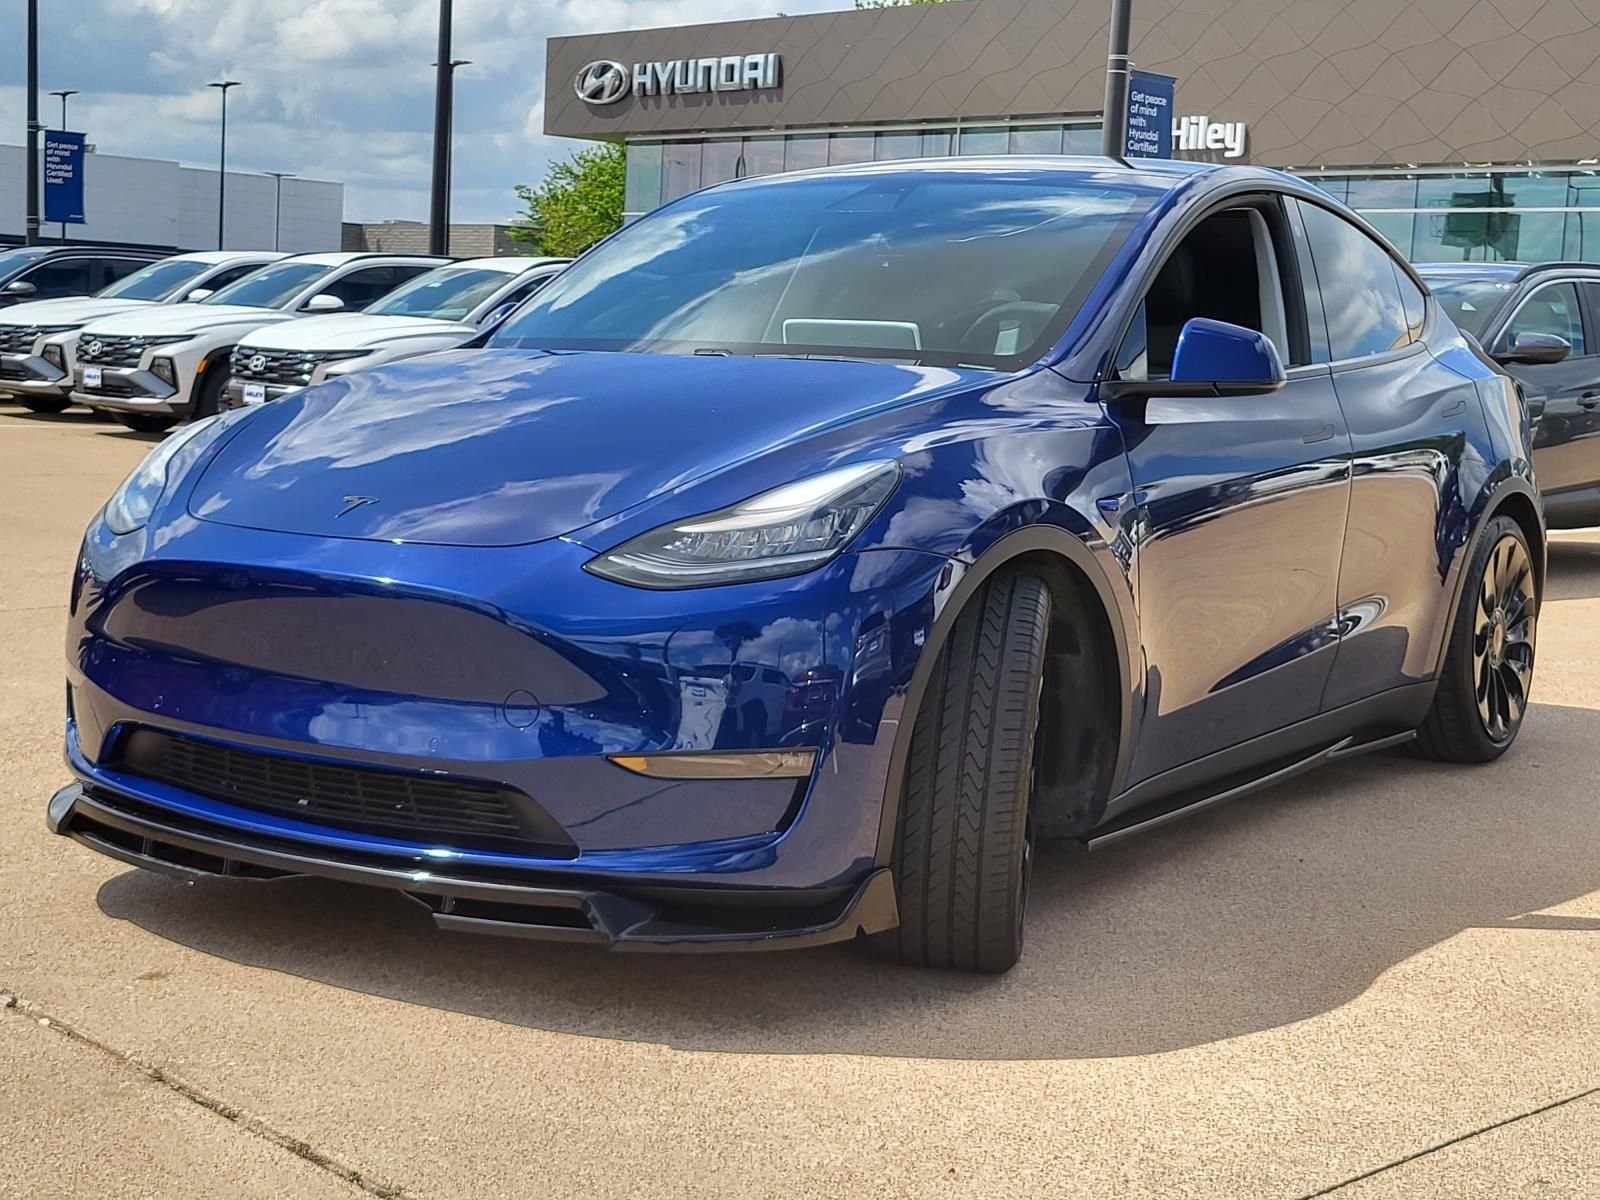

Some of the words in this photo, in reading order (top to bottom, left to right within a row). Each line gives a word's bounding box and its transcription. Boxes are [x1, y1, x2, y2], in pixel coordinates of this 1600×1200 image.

[632, 52, 780, 97] HYUNDAI
[1131, 91, 1144, 102] Get
[1145, 95, 1167, 106] peace
[1130, 103, 1140, 113] of
[1140, 106, 1157, 116] mind
[1129, 116, 1146, 127] with
[1128, 128, 1159, 141] Hyundai
[1171, 115, 1246, 158] Hiley
[1127, 140, 1158, 153] Certified
